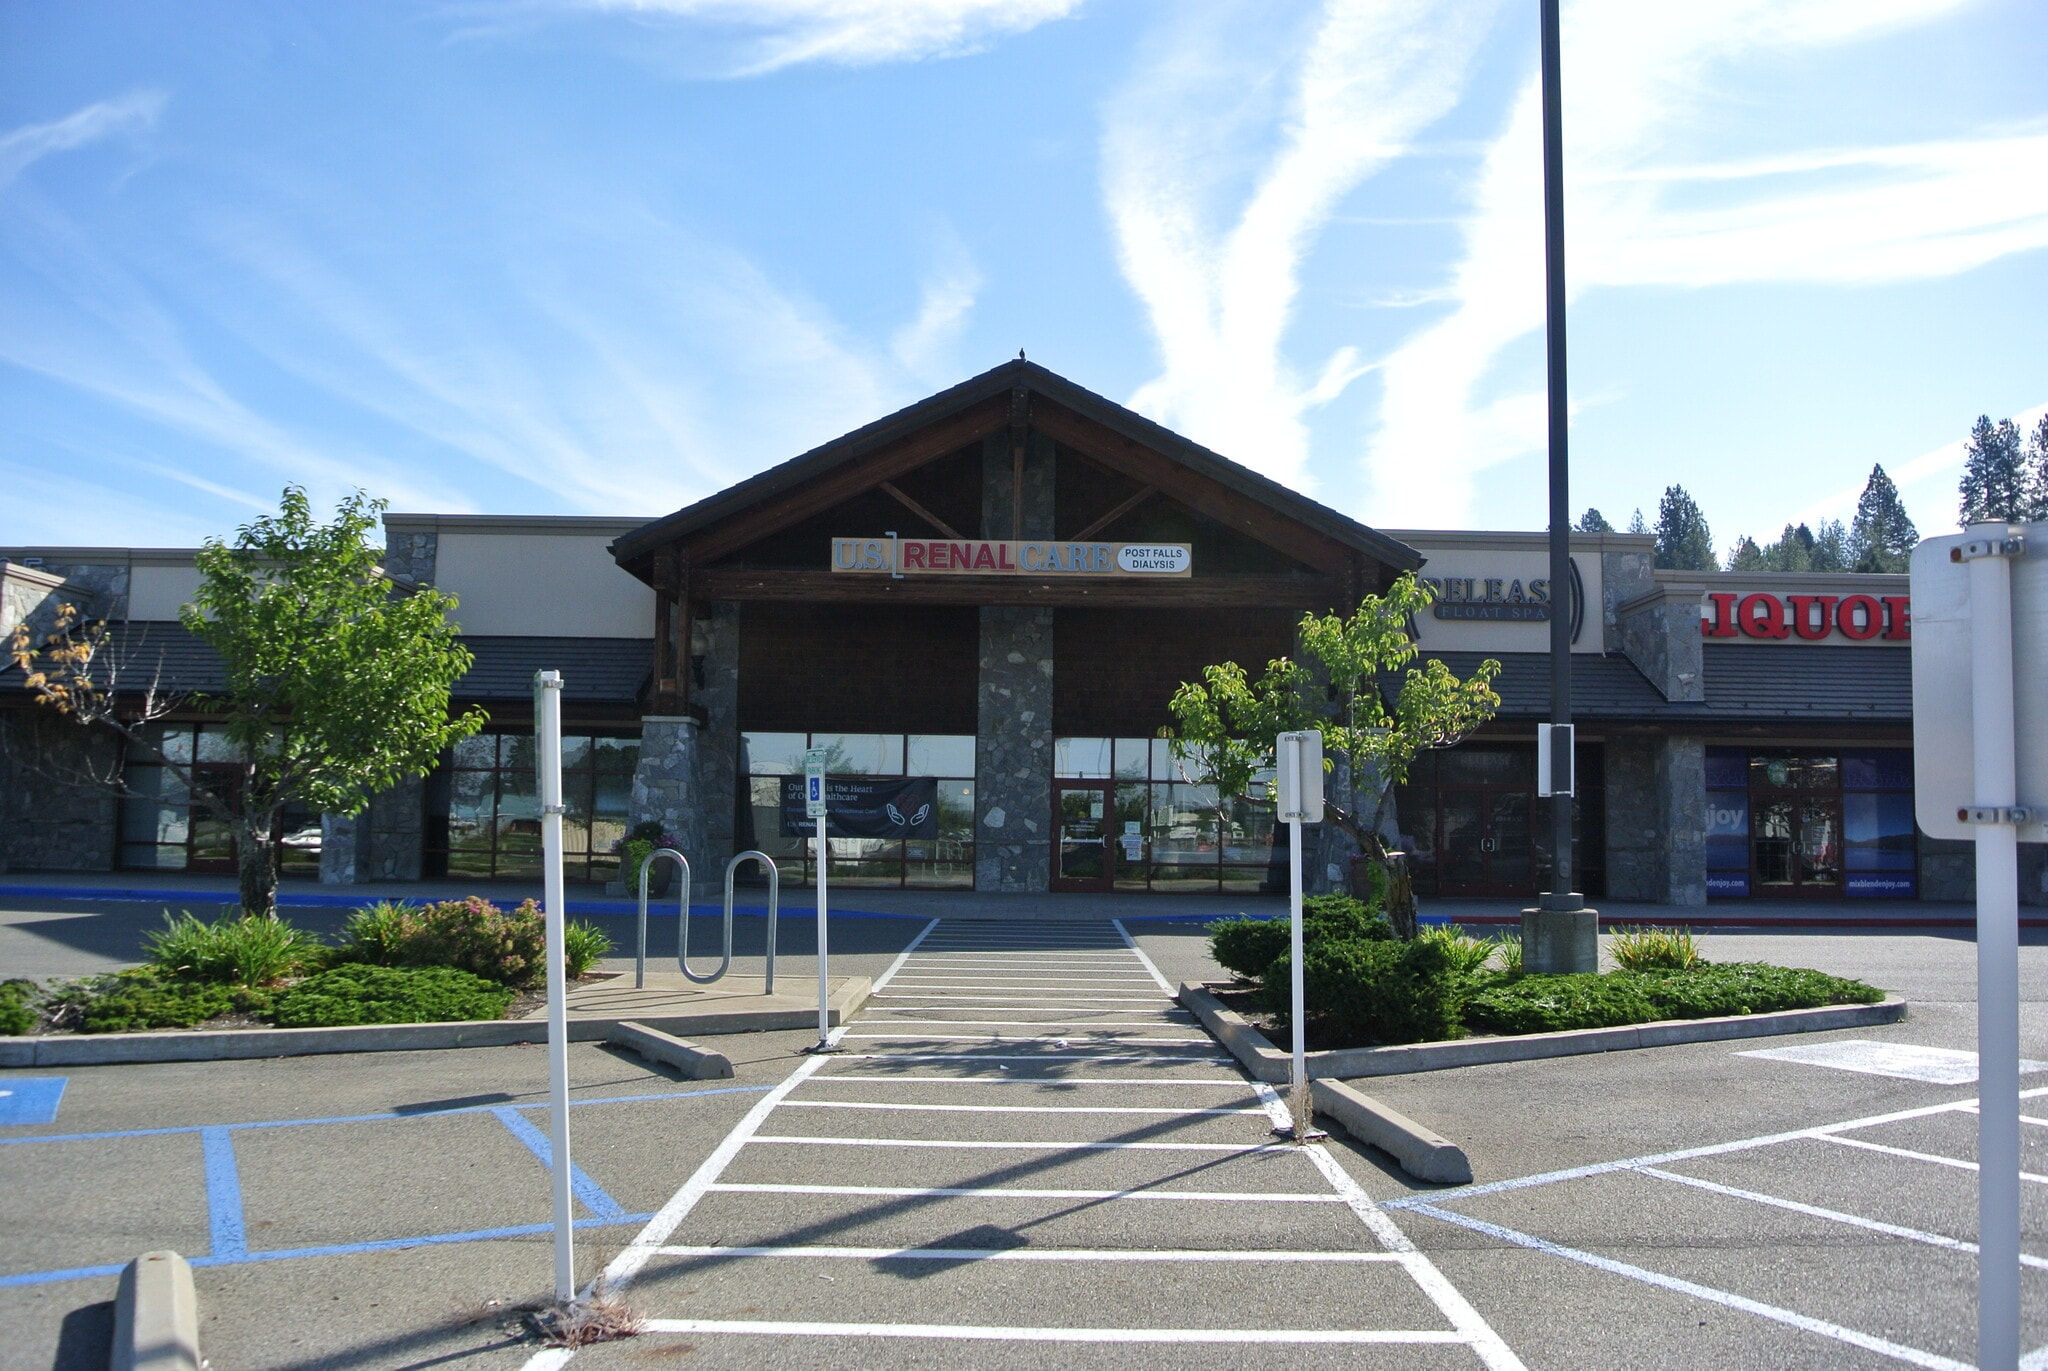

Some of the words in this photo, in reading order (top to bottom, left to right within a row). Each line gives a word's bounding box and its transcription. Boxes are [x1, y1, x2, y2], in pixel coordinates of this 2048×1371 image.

[833, 540, 889, 570] U.S.
[903, 542, 1016, 571] RENAL
[1019, 543, 1114, 573] CARE
[1125, 549, 1150, 558] POST
[1153, 549, 1182, 558] FALLS
[1132, 560, 1175, 569] DIALYSIS
[1422, 577, 1550, 604] RELEAS
[1442, 607, 1501, 618] FLOAT
[1512, 608, 1545, 619] SPA
[1702, 593, 1911, 640] IQUOR
[788, 783, 804, 791] Our
[827, 783, 833, 792] is
[835, 784, 848, 793] the
[850, 785, 873, 793] Heart
[788, 792, 796, 800] of
[798, 792, 806, 800] Ou
[825, 792, 858, 801] althcare
[1849, 879, 1911, 890] mixblendenjoy.com
